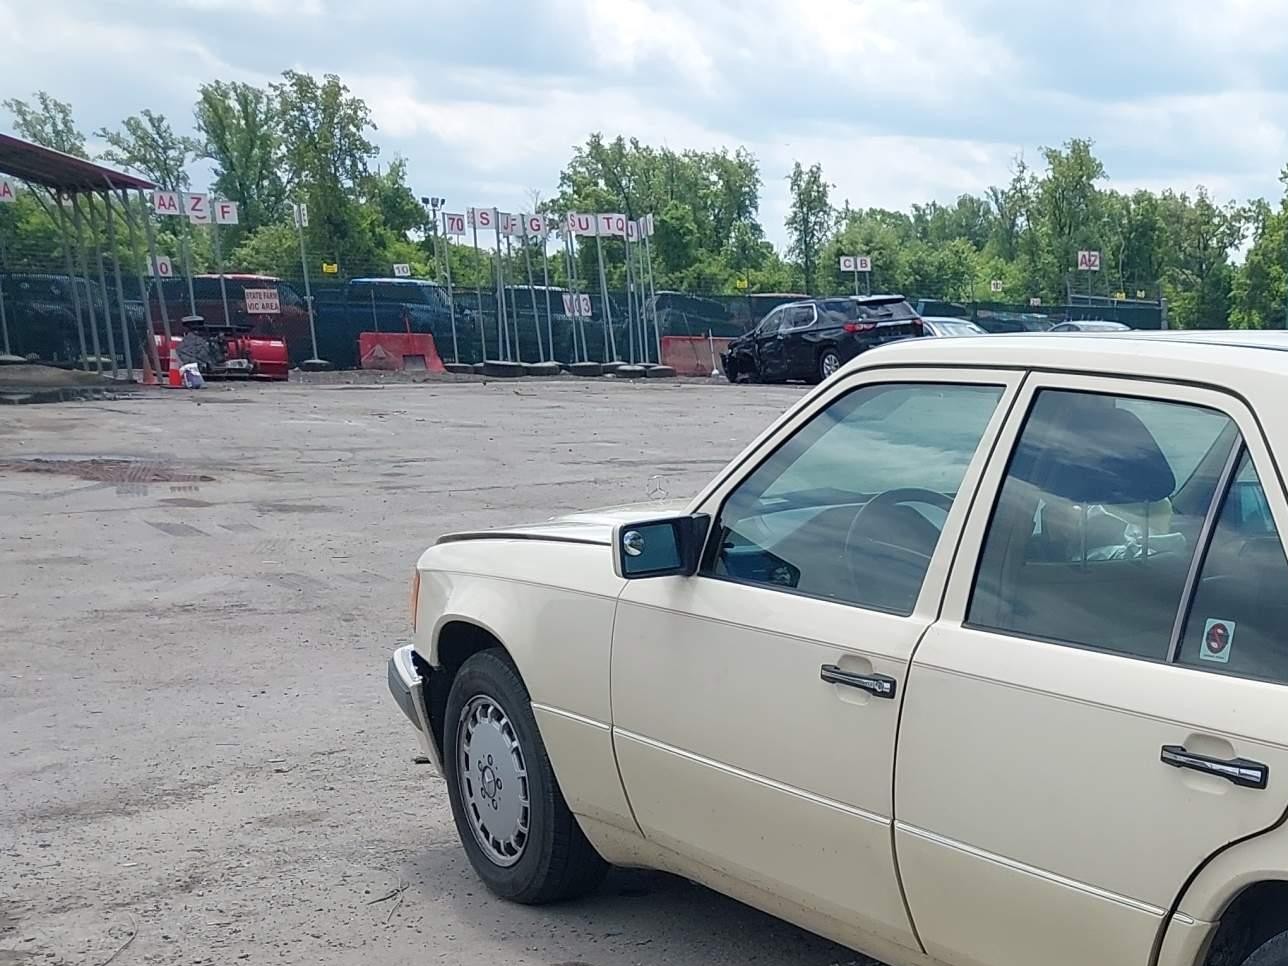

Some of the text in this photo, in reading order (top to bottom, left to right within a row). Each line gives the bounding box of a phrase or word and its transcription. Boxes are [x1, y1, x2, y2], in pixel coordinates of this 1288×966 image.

[157, 195, 177, 211] AA
[190, 196, 203, 212] Z
[220, 205, 230, 219] F
[480, 211, 490, 226] S
[448, 217, 464, 231] 70
[529, 218, 541, 231] G
[578, 217, 589, 231] U
[602, 217, 613, 230] T
[395, 265, 409, 275] 10
[843, 258, 852, 269] C
[860, 259, 868, 269] B
[246, 291, 262, 300] STATE
[248, 303, 279, 311] VIC AREA
